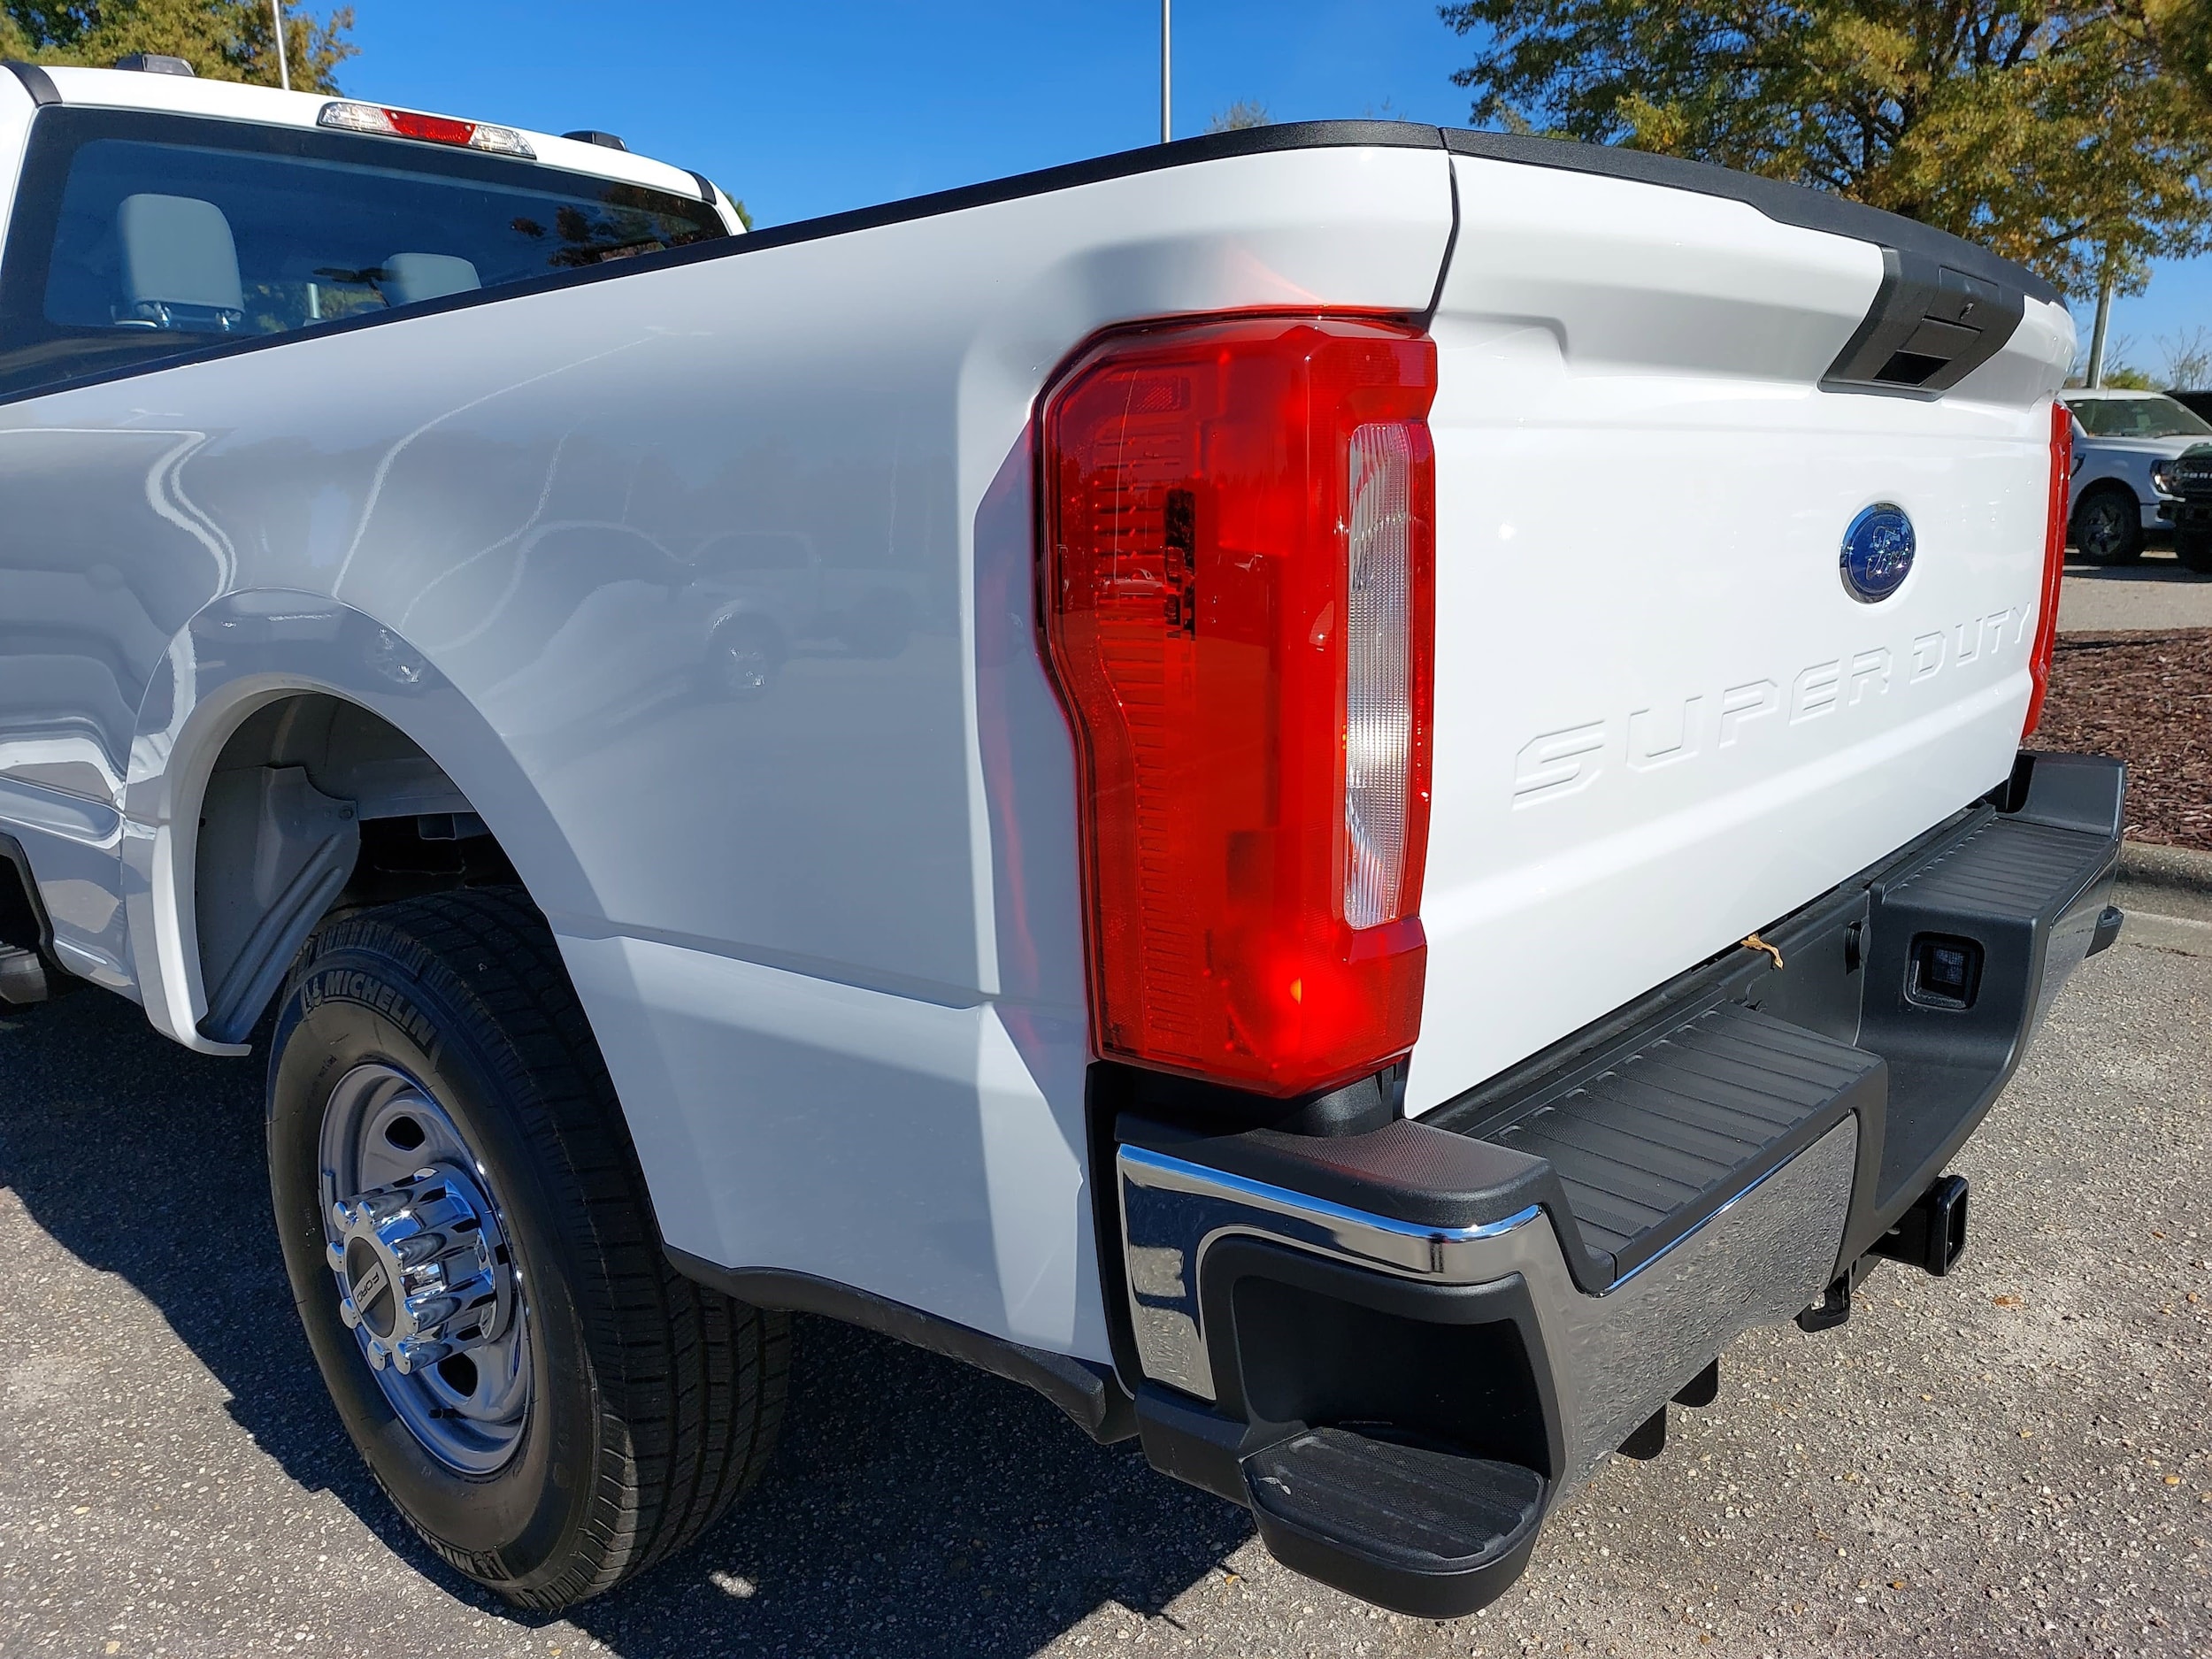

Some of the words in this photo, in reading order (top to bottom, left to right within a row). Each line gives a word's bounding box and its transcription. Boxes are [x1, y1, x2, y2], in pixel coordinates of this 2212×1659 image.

[1511, 646, 1893, 812] SUPER
[1909, 602, 2032, 686] DUTY
[325, 970, 440, 1048] MICHELIN
[357, 1271, 380, 1302] FORD
